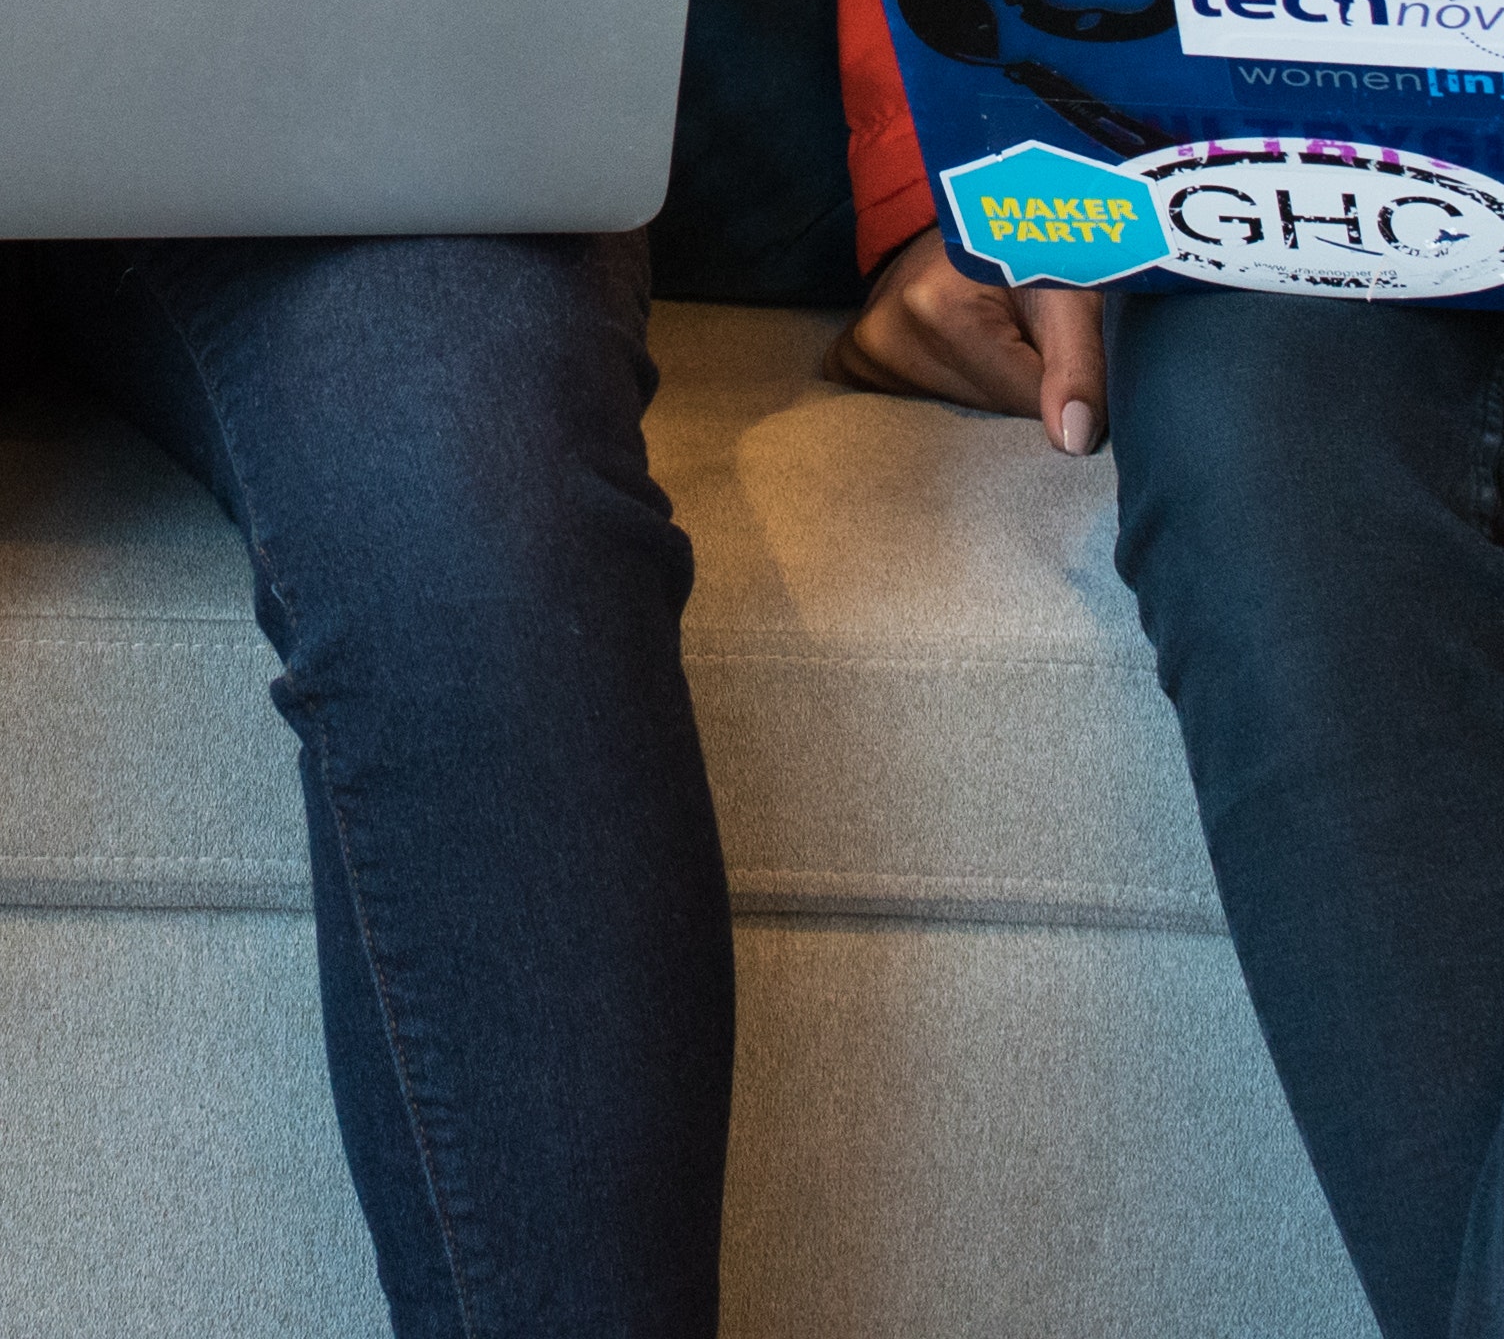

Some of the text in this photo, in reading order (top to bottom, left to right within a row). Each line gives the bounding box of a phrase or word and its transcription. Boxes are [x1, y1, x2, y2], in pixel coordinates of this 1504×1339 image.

[980, 196, 1139, 220] MAKER
[989, 219, 1126, 243] PARTY
[1169, 185, 1464, 259] GHC
